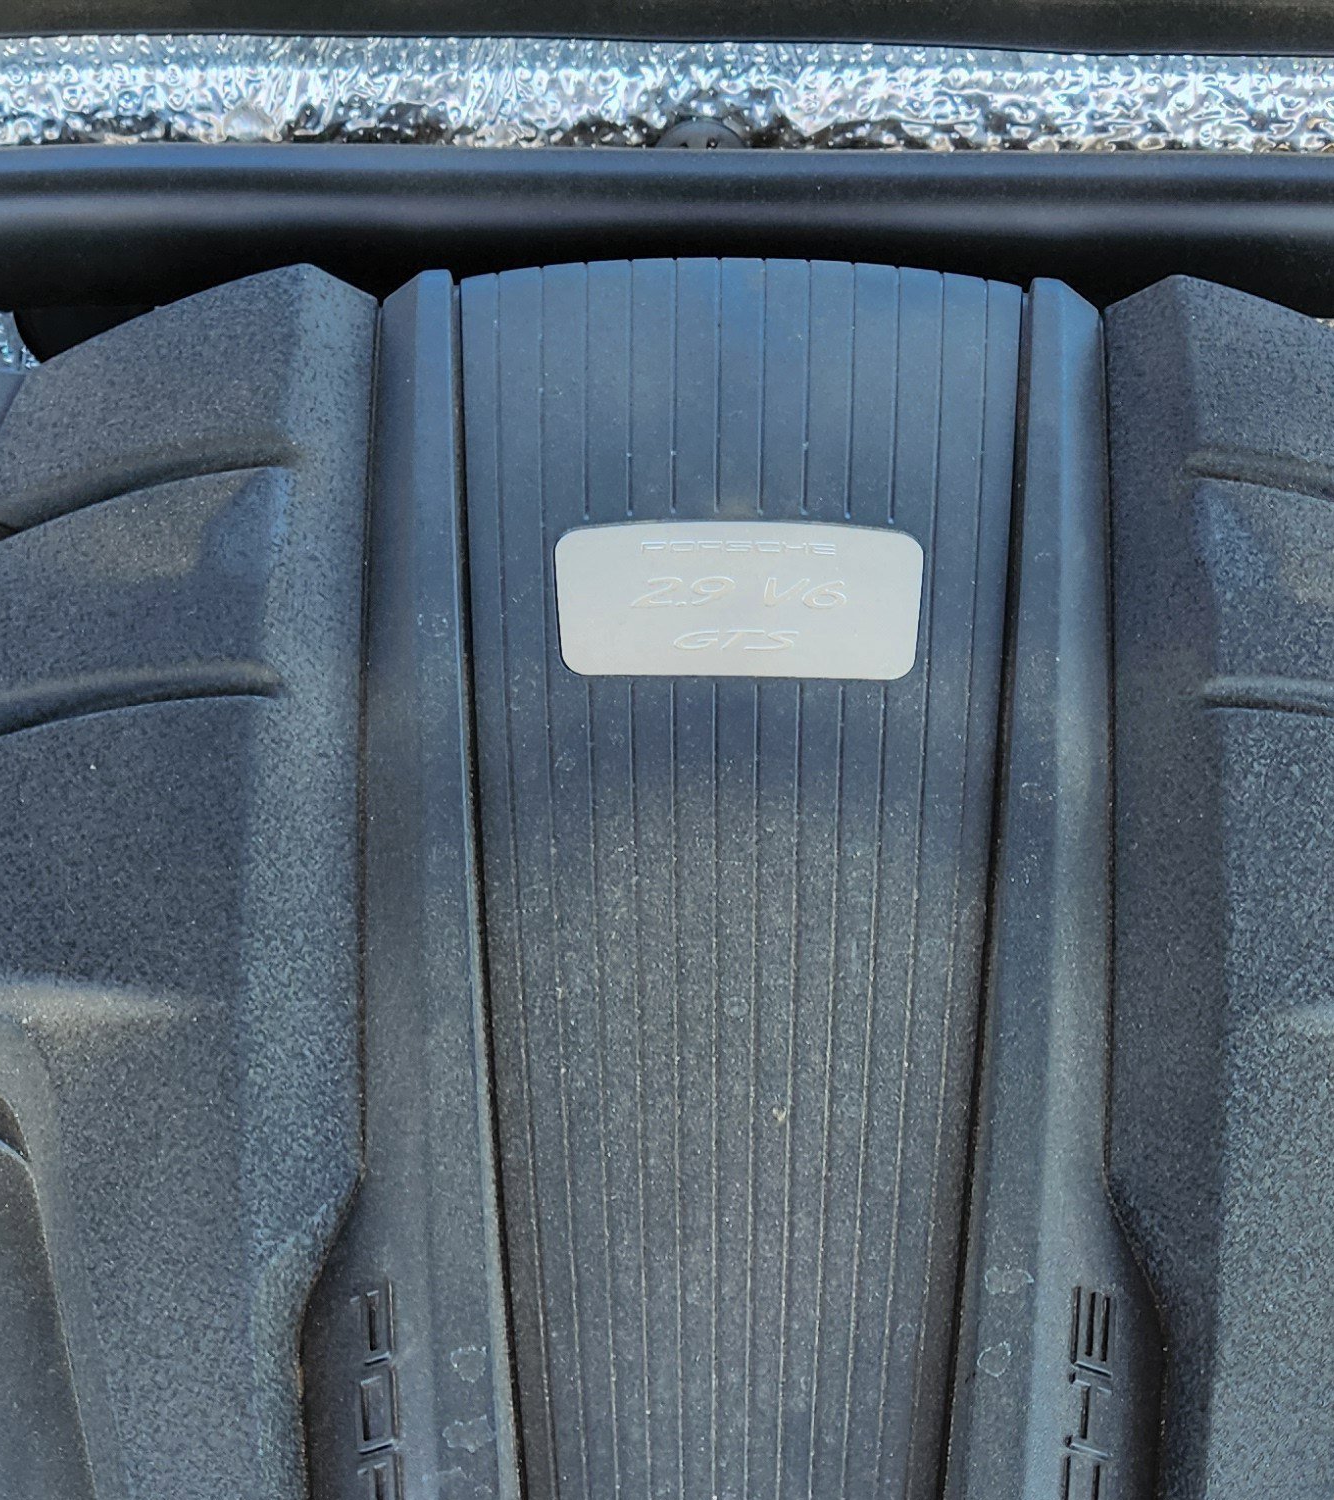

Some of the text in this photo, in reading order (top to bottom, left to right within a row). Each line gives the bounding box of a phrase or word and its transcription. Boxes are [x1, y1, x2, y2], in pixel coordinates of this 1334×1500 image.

[639, 539, 837, 557] PORSCHE
[630, 576, 848, 609] 2.9 V6
[672, 629, 800, 651] GTS
